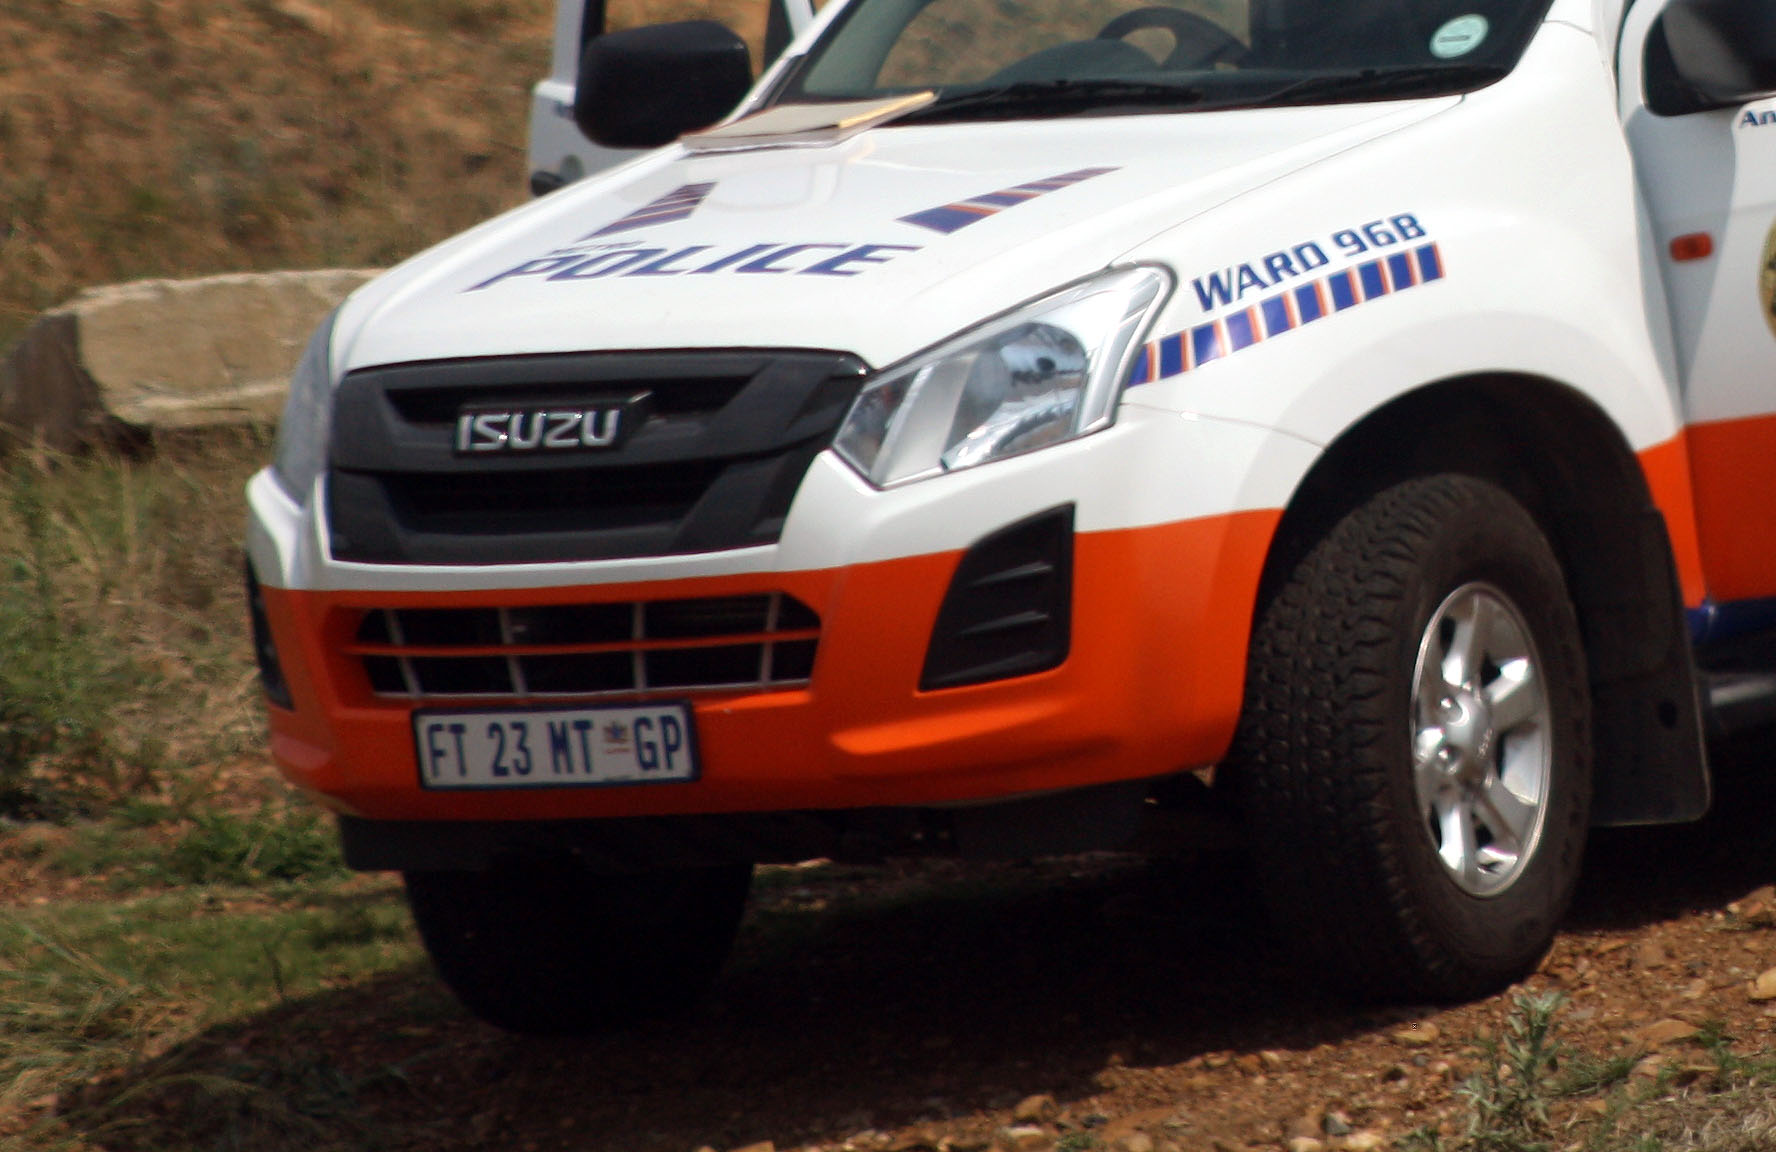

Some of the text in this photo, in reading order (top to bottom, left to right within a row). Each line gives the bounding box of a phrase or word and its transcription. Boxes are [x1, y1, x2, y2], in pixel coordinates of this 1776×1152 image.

[460, 243, 924, 293] POLICE
[1192, 239, 1330, 312] WARD
[457, 409, 620, 450] ISUZU
[426, 722, 467, 778] FT
[487, 721, 532, 776] 23
[633, 715, 682, 771] GP
